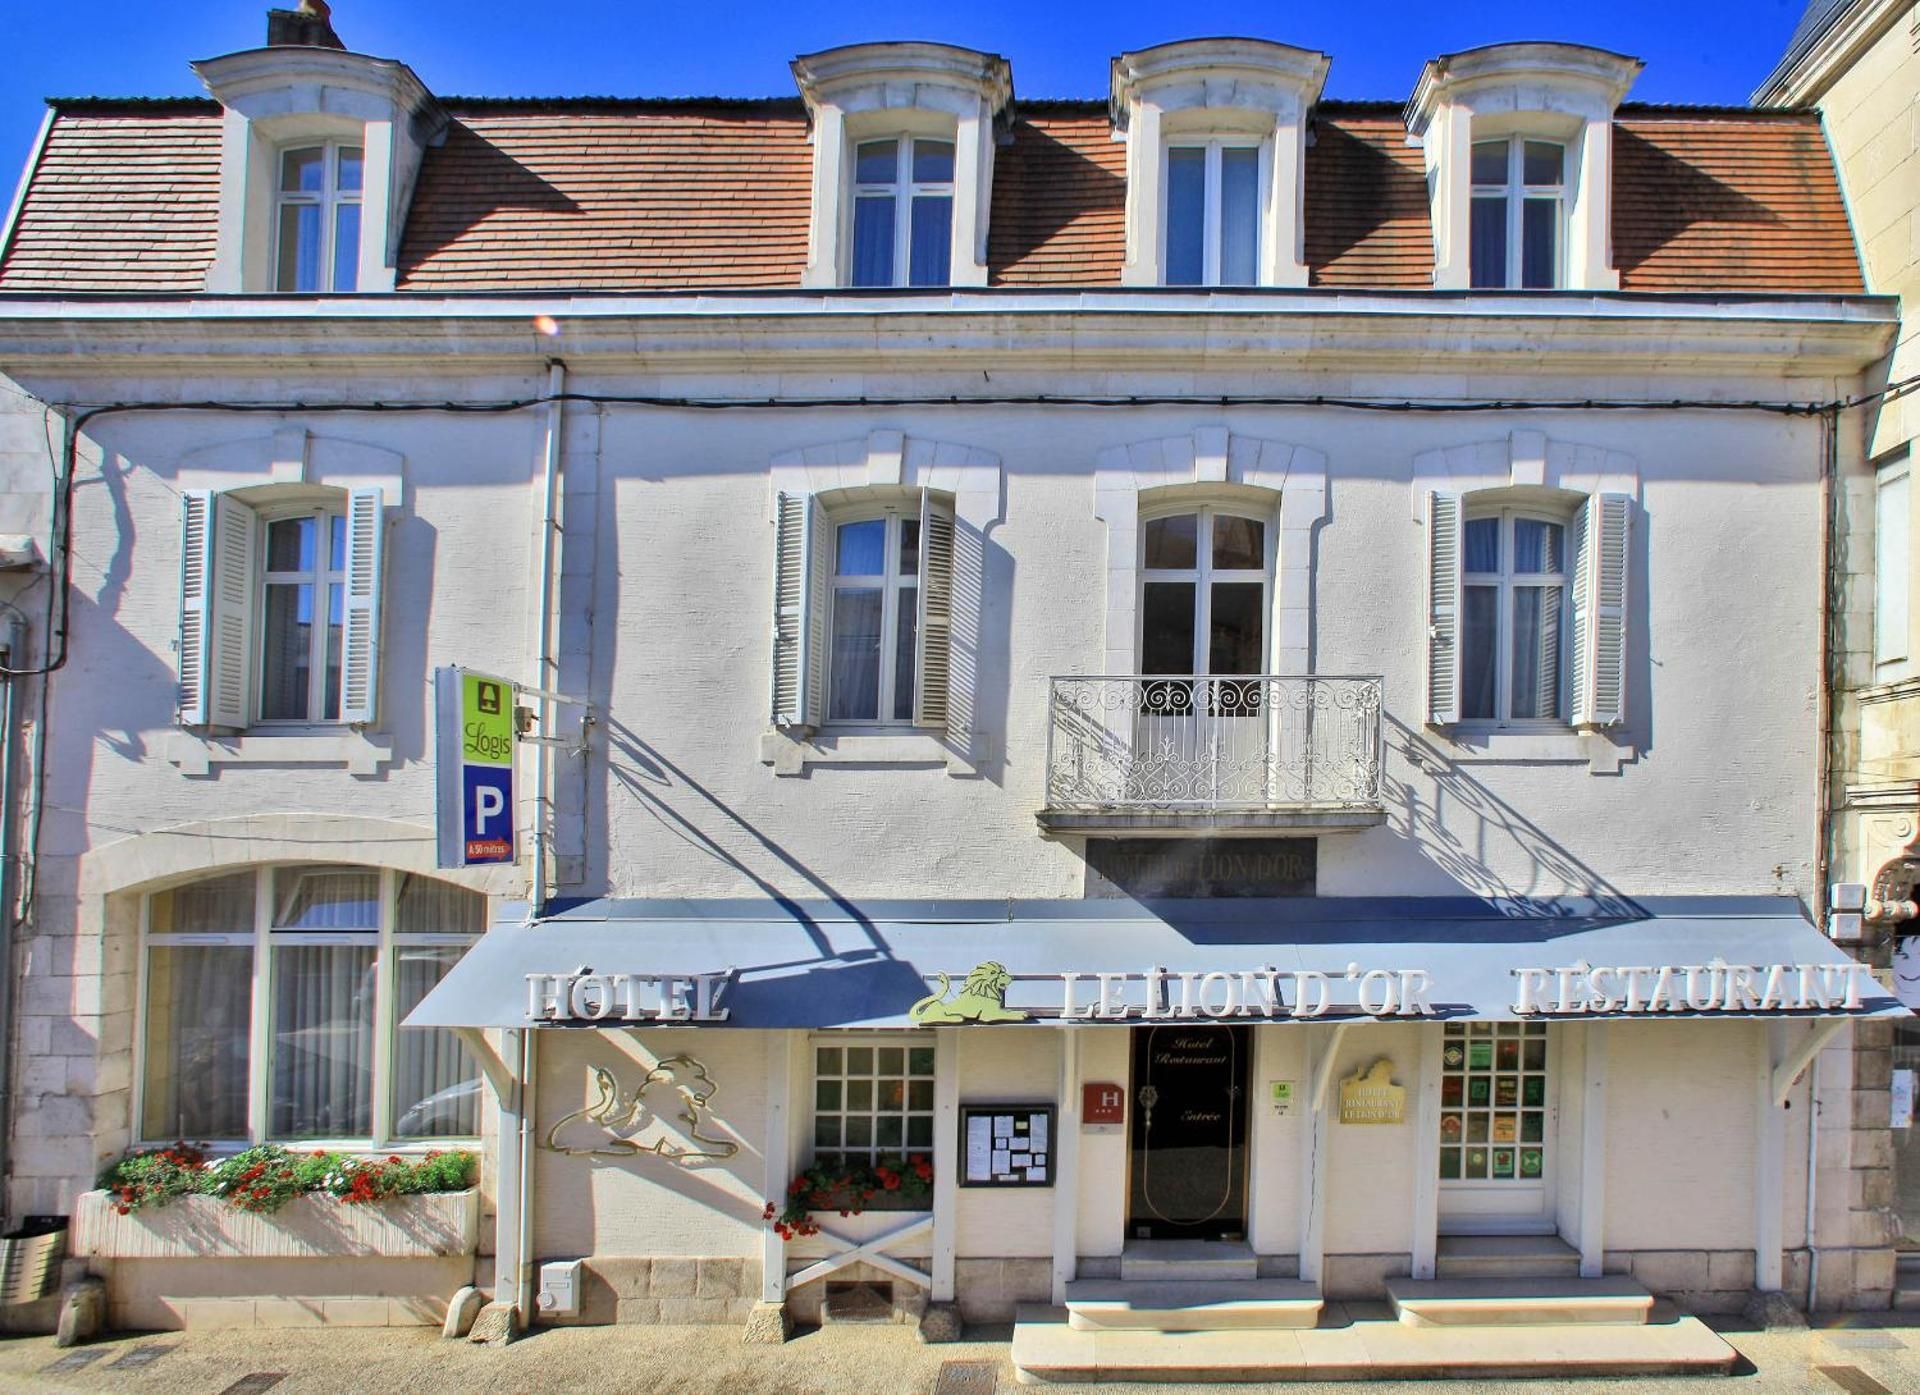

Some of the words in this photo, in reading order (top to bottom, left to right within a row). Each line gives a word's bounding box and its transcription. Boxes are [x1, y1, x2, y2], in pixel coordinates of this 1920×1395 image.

[465, 722, 510, 759] Logis
[476, 785, 504, 835] P
[1059, 972, 1128, 1018] LE
[1142, 971, 1279, 1018] LION
[1290, 962, 1437, 1017] D'OR
[1513, 964, 1872, 1014] RESTAURANT
[1154, 1051, 1227, 1065] Restaurant
[1102, 1091, 1119, 1107] H
